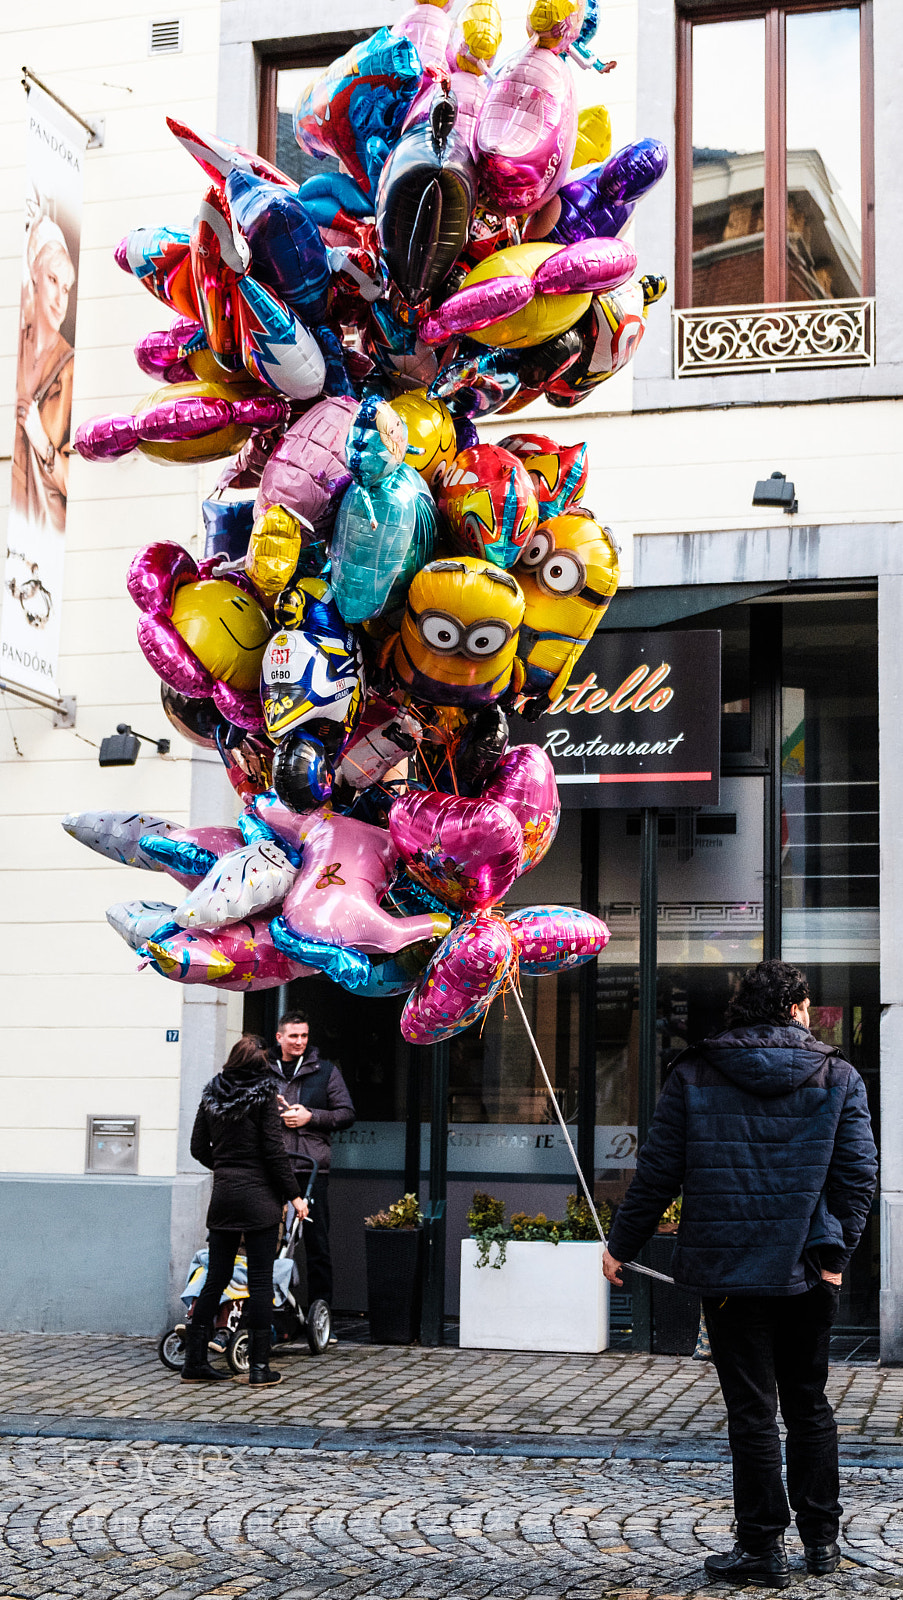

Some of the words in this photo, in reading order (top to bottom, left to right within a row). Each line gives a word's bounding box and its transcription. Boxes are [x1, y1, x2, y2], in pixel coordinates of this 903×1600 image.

[30, 117, 80, 173] PANDORA
[2, 642, 53, 678] PANDORA
[547, 662, 674, 715] tello
[541, 729, 685, 757] Restaurant
[167, 1031, 178, 1042] 17
